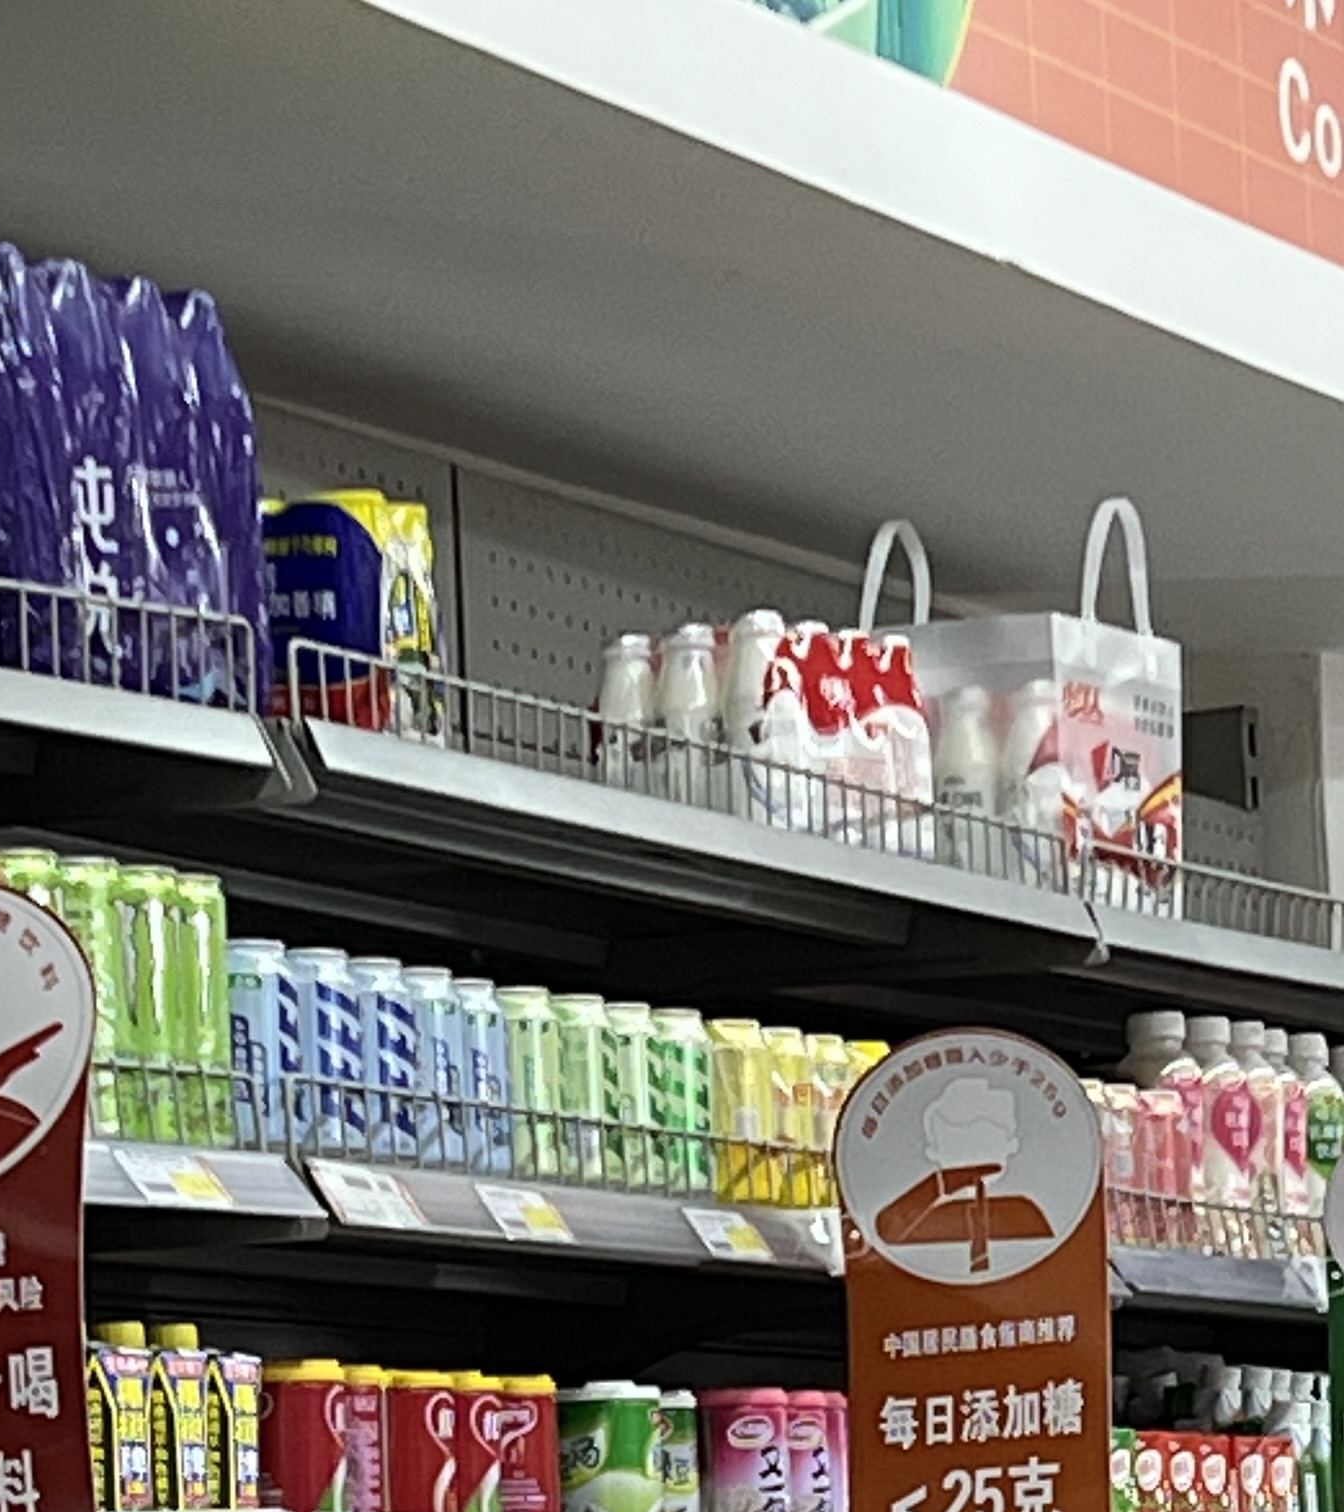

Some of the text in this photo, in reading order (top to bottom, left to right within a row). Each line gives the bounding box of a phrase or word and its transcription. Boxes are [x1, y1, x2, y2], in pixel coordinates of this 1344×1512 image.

[878, 1378, 1085, 1450] 每日添加糖
